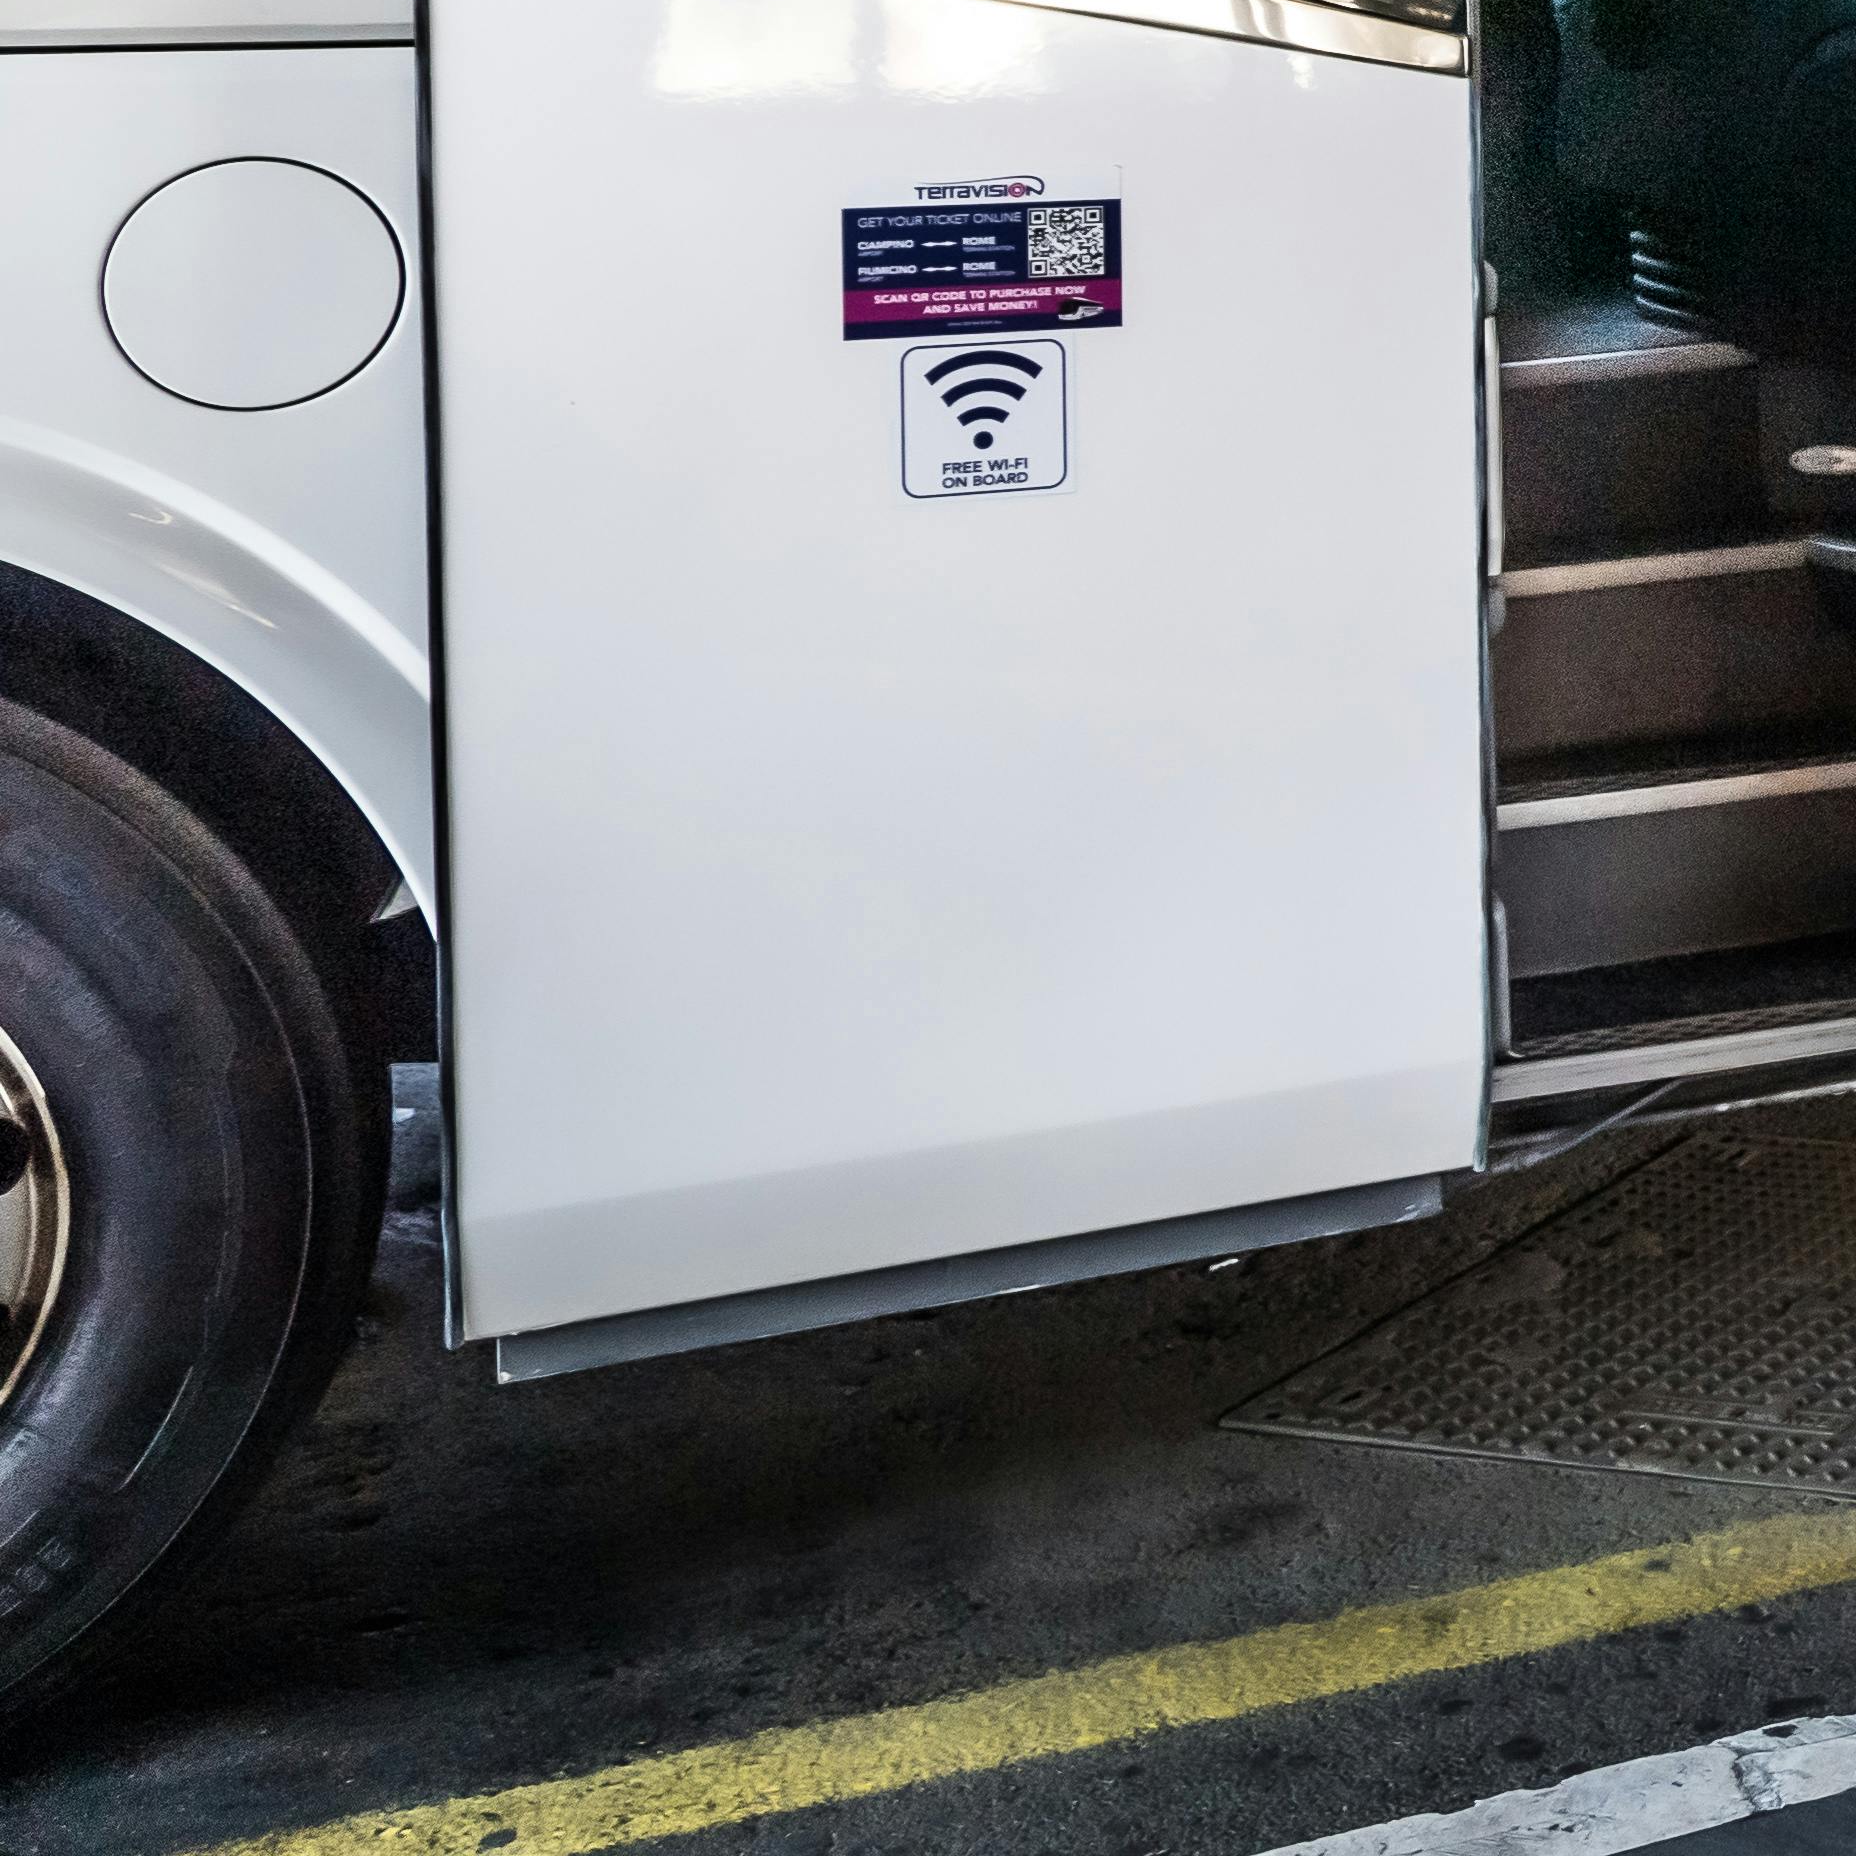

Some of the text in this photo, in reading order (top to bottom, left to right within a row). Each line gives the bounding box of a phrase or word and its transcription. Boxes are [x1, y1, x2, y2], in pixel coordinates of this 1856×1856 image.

[858, 211, 1022, 228] GET YOUR TICKET ONLINE
[874, 294, 908, 304] SCAN
[931, 291, 967, 301] CODE
[970, 290, 986, 299] TO
[989, 286, 1052, 298] PURCHASE
[1055, 285, 1086, 295] NOW
[923, 304, 951, 314] AND
[954, 302, 985, 312] SAVE
[942, 457, 1028, 475] FREE WI-FI
[942, 472, 1029, 489] ON BOARD
